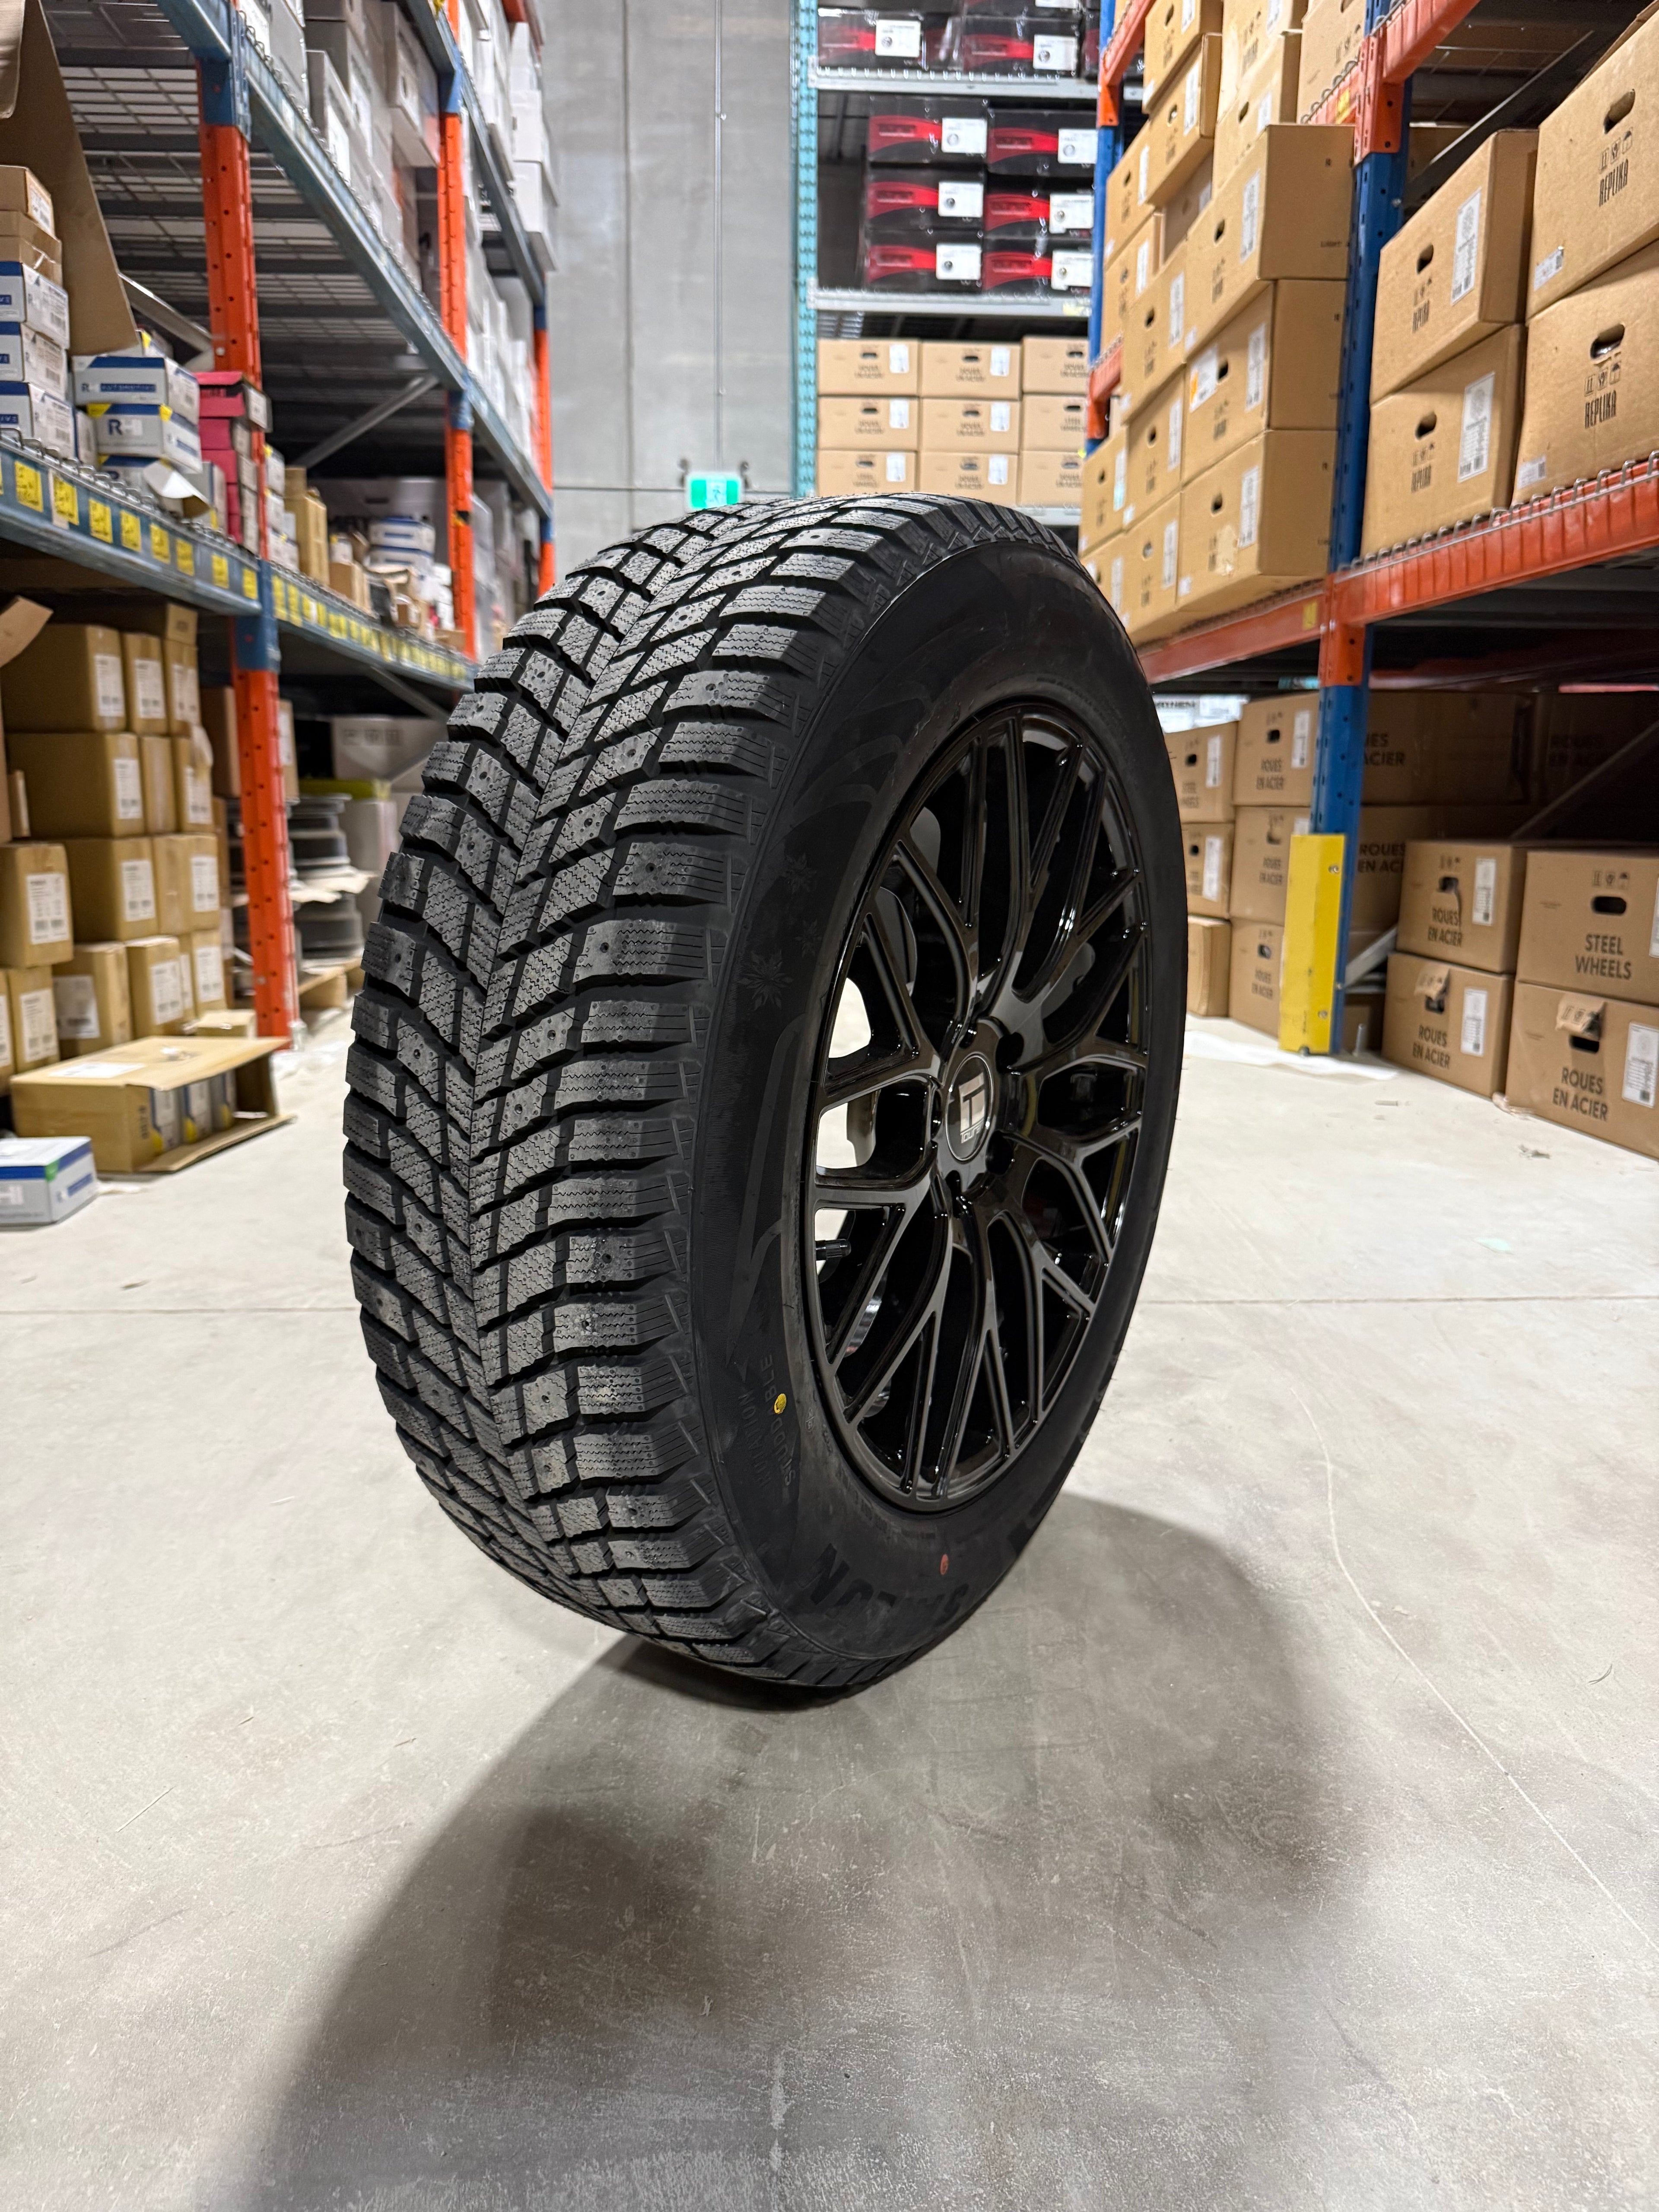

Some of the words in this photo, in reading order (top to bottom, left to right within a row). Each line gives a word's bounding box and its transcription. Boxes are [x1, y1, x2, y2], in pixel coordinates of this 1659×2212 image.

[1599, 158, 1629, 208] REPLIKA
[1584, 389, 1617, 429] REPLIKA
[1431, 907, 1459, 926] ROUES
[1427, 927, 1440, 942] EN
[1440, 927, 1462, 947] ACIER
[1585, 933, 1624, 956] STEEL
[1574, 954, 1632, 981] WHEELS
[1418, 1024, 1448, 1048] ROUES
[1412, 1042, 1425, 1060] EN
[1425, 1046, 1450, 1070] ACIER
[1561, 1066, 1603, 1096] ROUES
[1551, 1087, 1570, 1109] EN
[1572, 1096, 1608, 1122] ACIER
